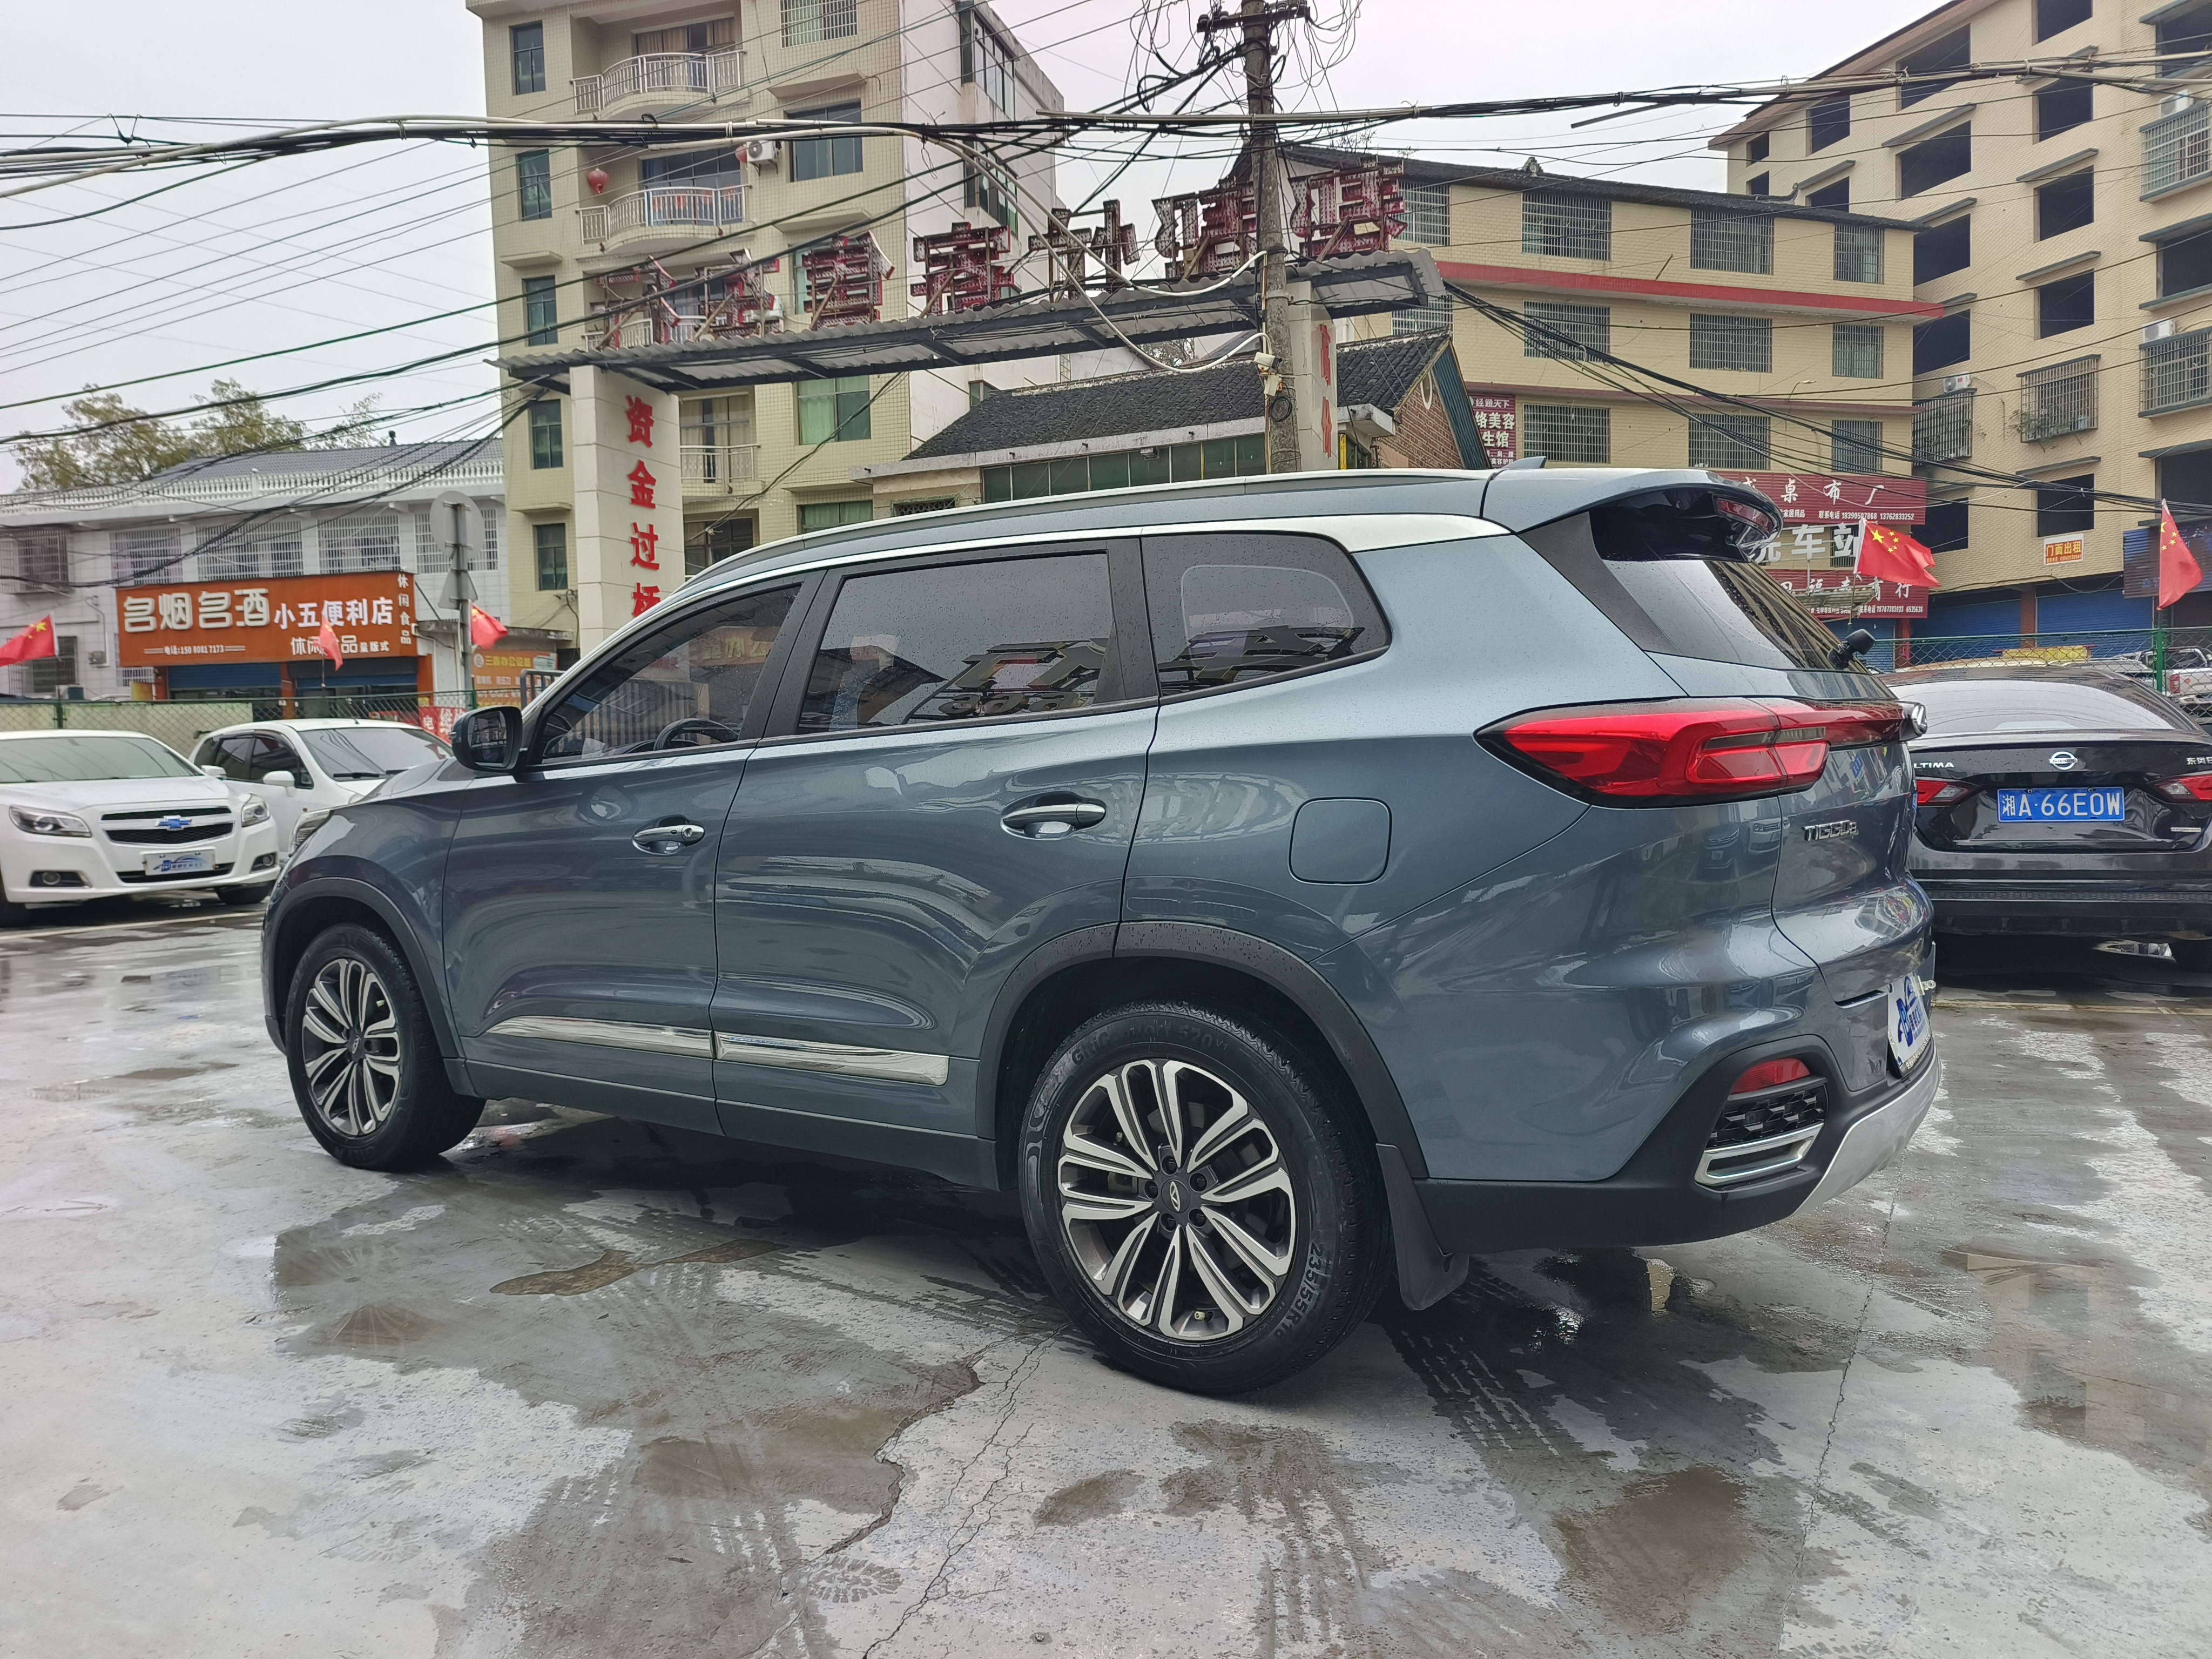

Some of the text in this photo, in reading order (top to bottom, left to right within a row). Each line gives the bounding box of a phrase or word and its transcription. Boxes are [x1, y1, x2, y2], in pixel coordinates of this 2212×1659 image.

[1475, 398, 1510, 409] 经通天下
[1475, 411, 1515, 430] 络美容
[1482, 430, 1509, 448] 生馆
[1781, 509, 1805, 518] 家居用品
[1818, 510, 1840, 520] 联系电话
[1880, 512, 1914, 521] 13762833252
[2046, 541, 2082, 557] 门面出租
[123, 588, 394, 633] 名烟名酒 小五便利店
[397, 574, 412, 645] 休闲食品
[290, 635, 359, 656] 休闲品
[1273, 1242, 1325, 1340] 235/55R18
